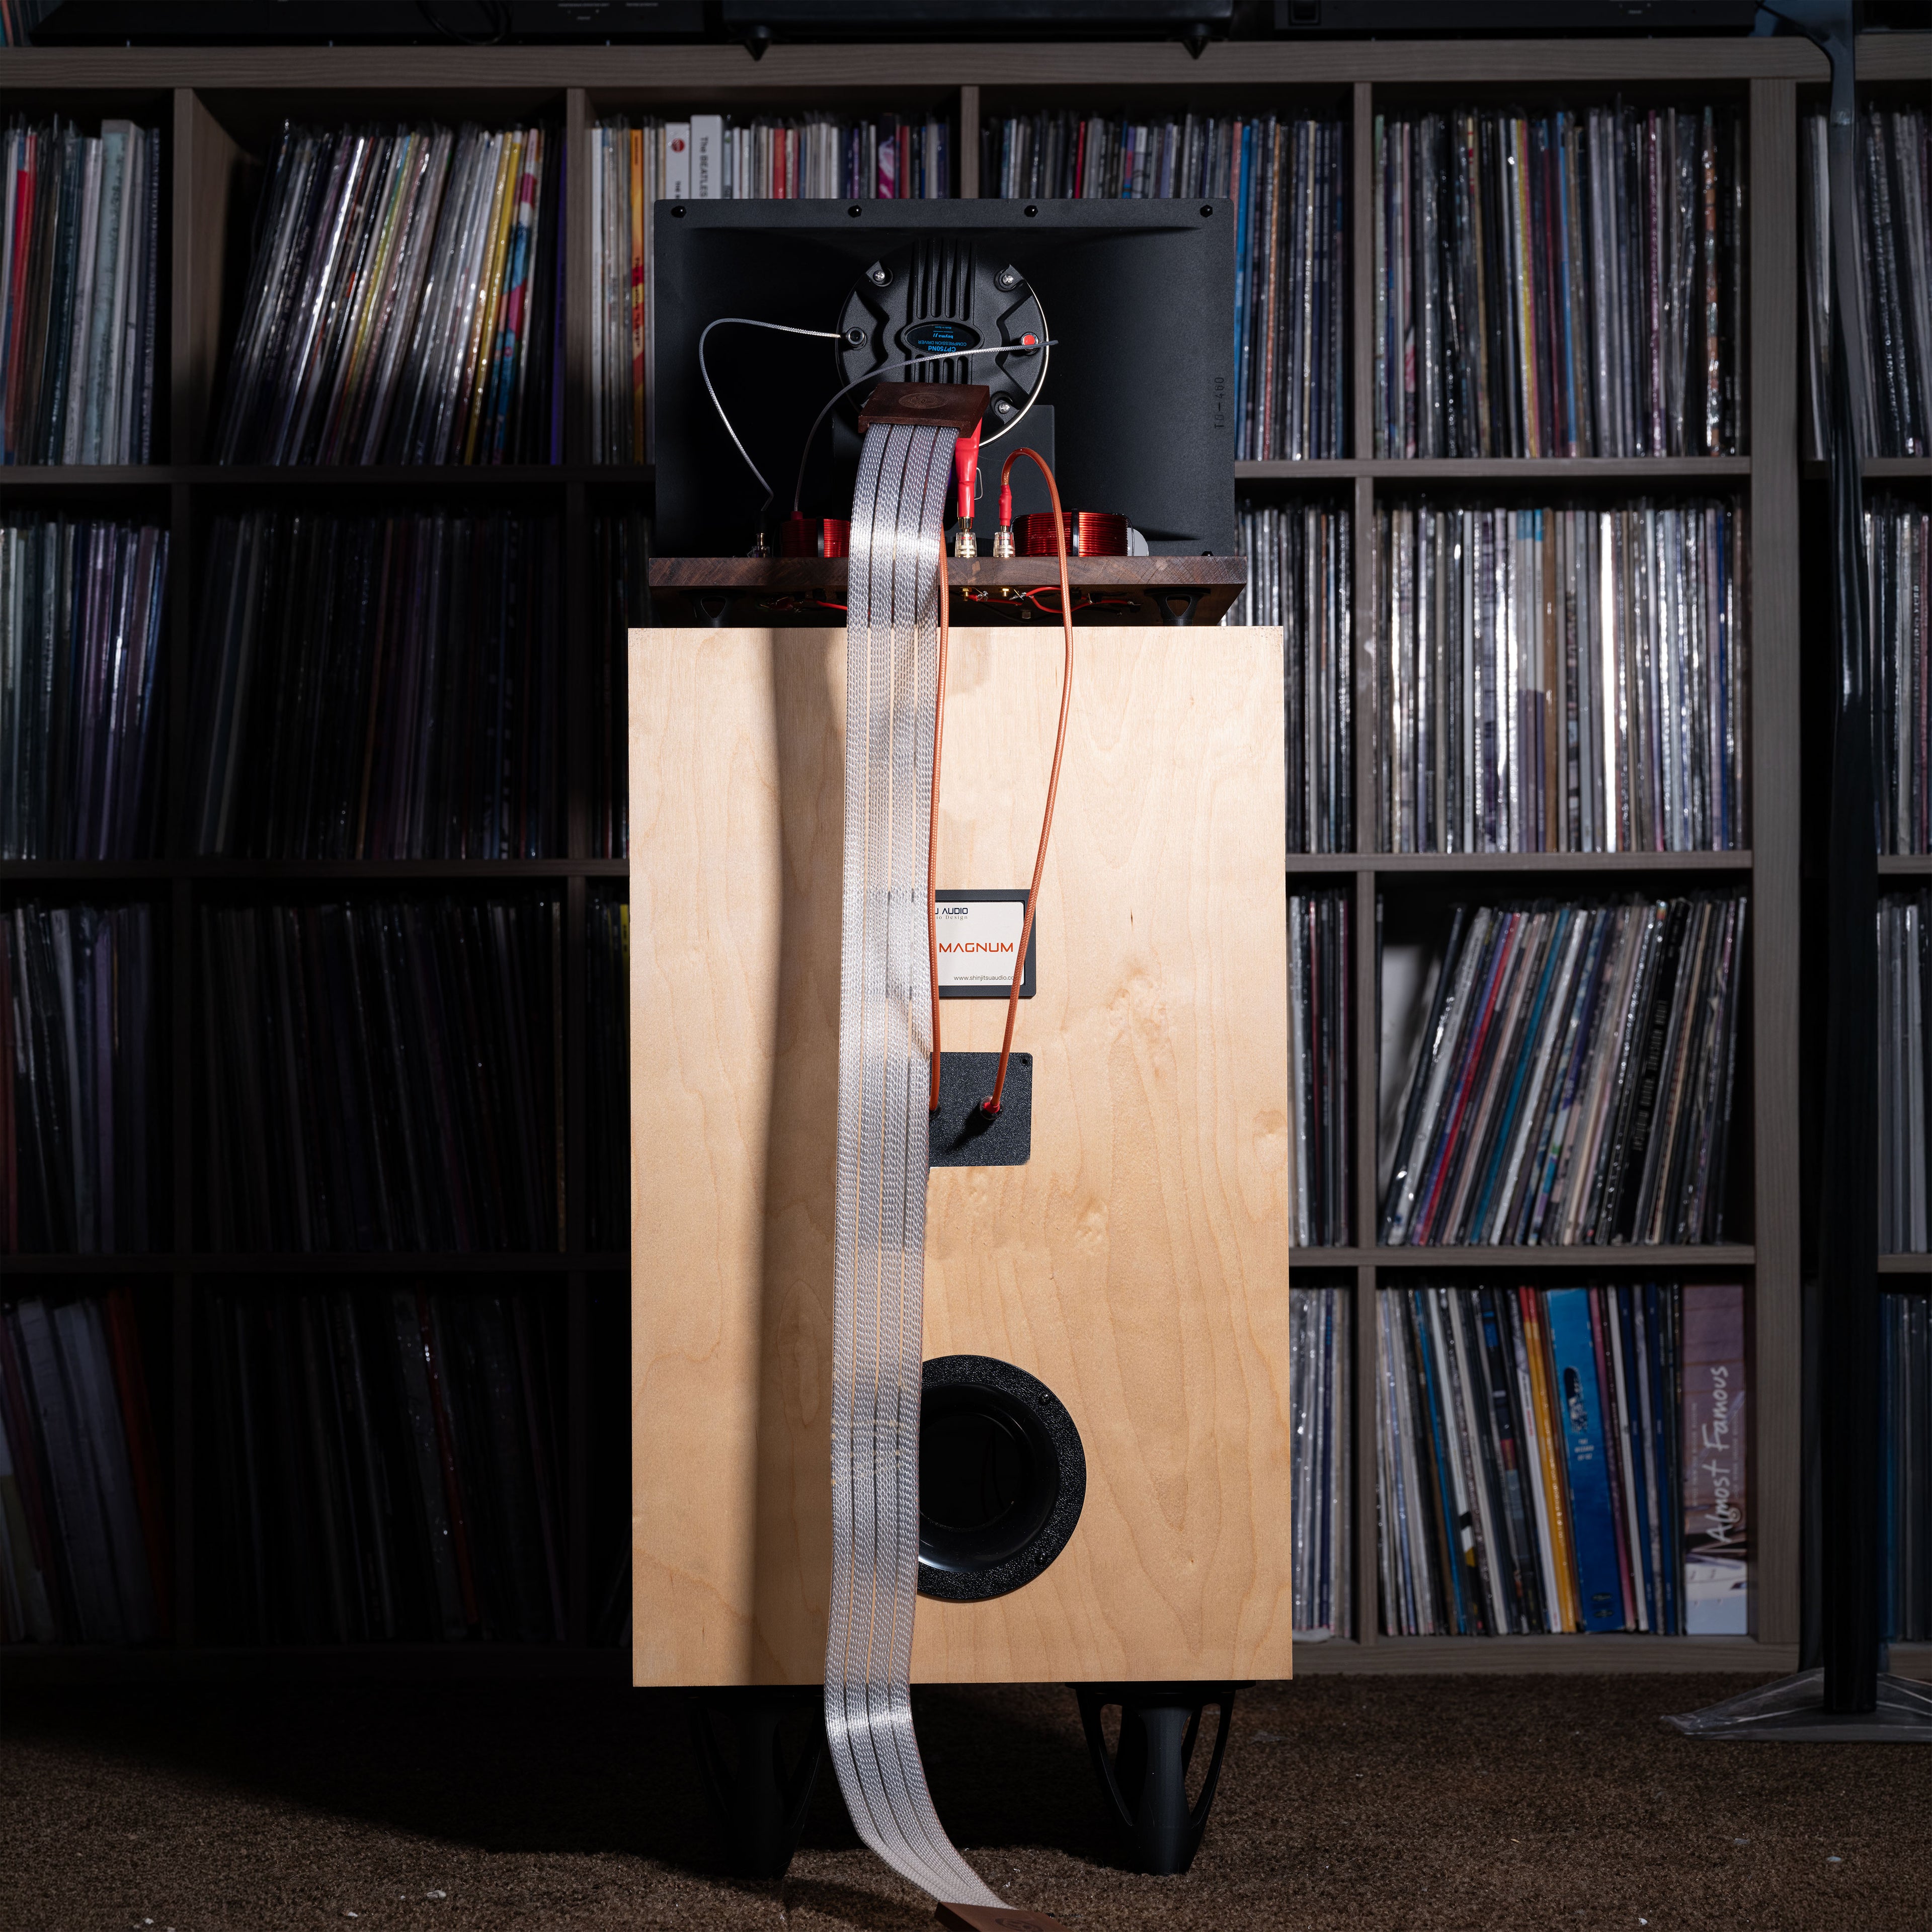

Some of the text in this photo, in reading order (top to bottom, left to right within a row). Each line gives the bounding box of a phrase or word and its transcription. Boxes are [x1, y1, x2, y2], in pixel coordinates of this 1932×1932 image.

[699, 155, 708, 198] BEATLES
[939, 942, 1013, 952] MAGNUM
[1701, 1365, 1741, 1543] Almost Famous
